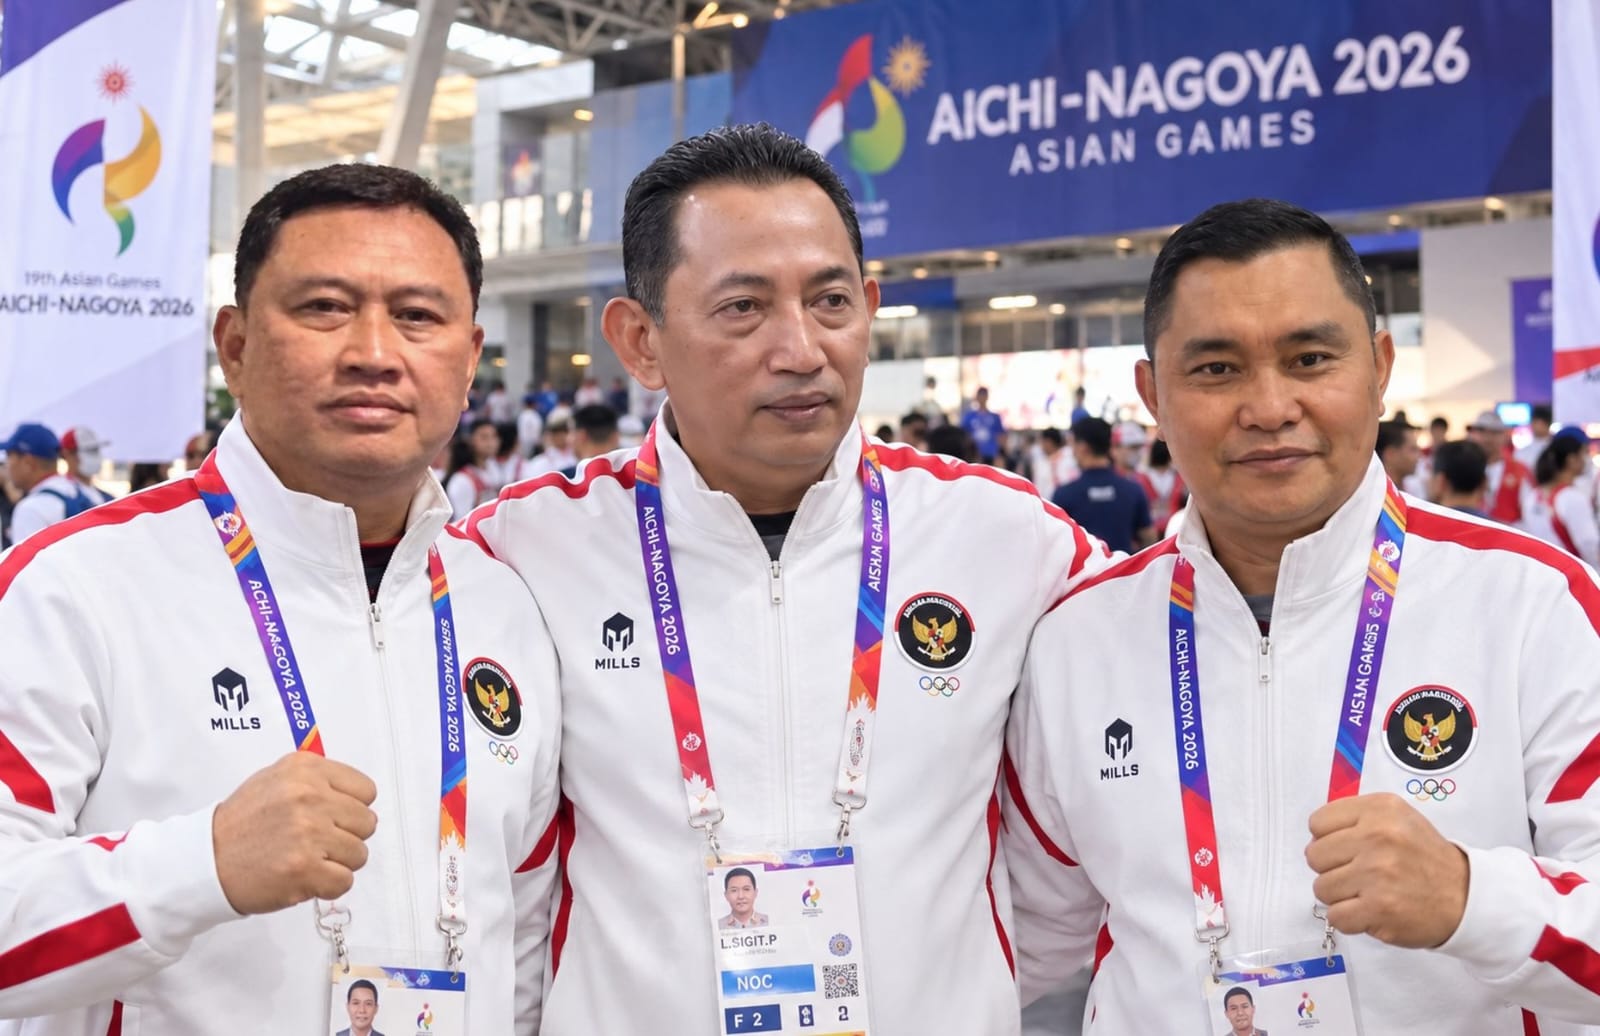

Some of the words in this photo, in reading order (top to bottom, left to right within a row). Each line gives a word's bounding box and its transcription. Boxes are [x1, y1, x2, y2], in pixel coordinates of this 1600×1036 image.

[927, 43, 1322, 146] AICHI-NAGOYA
[1333, 25, 1471, 95] 2026
[1009, 128, 1137, 176] ASIAN
[1155, 109, 1316, 159] GAMES
[24, 271, 55, 287] 19th
[60, 272, 103, 288] Asian
[107, 273, 161, 290] Games
[0, 294, 143, 316] AICHI-NAGOYA
[149, 297, 195, 316] 2026
[643, 505, 673, 614] AICHI-NAGOYA
[661, 615, 681, 656] 2026
[595, 657, 641, 671] MILLS
[1175, 628, 1195, 731] AICHI-NAGOYA
[210, 716, 262, 731] MILLS
[286, 689, 310, 731] 2026
[446, 716, 461, 753] 2026
[1183, 732, 1199, 770] 2026
[1100, 764, 1140, 781] MILLS
[736, 974, 774, 992] NOC
[734, 1014, 744, 1028] F
[752, 1012, 763, 1027] 2
